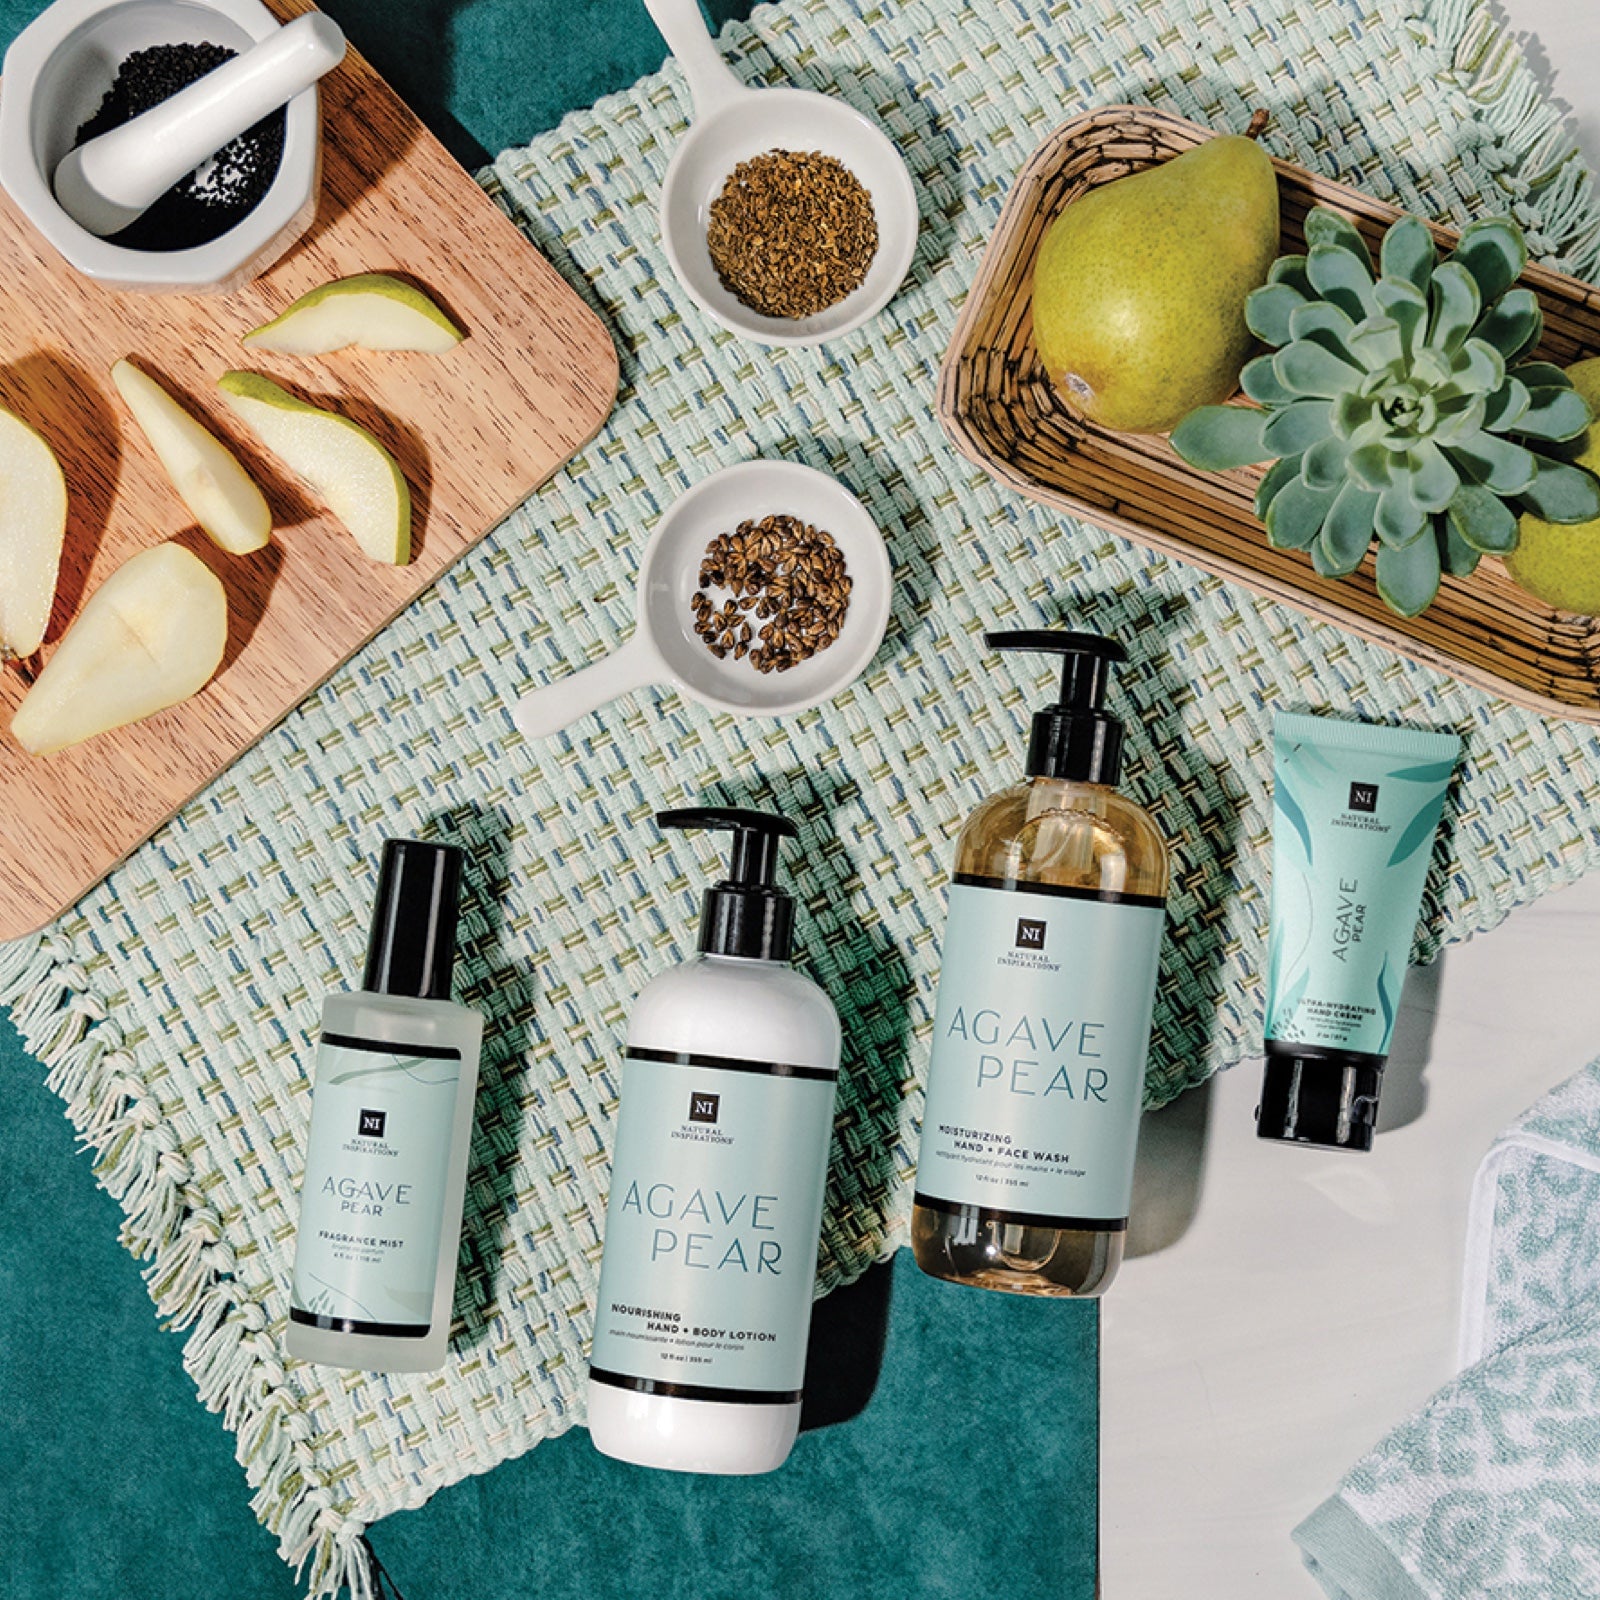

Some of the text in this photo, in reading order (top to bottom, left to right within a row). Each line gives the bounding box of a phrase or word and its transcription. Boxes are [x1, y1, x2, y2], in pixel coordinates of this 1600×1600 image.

[1355, 790, 1373, 805] NI
[1341, 813, 1380, 825] NATURAL
[1332, 878, 1358, 963] AGAVE
[1352, 904, 1367, 943] PEAR
[1022, 926, 1041, 942] NI
[1008, 951, 1049, 962] NATURAL
[1307, 1008, 1332, 1017] HAND
[947, 1006, 1105, 1058] AGAVE
[976, 1055, 1109, 1103] PEAR
[695, 1100, 714, 1115] NI
[363, 1116, 381, 1130] NI
[682, 1125, 722, 1136] NATURAL
[938, 1124, 1012, 1145] MOISTURIZING
[351, 1139, 389, 1150] NATURAL
[954, 1141, 983, 1153] HAND
[997, 1148, 1029, 1160] FACE
[1033, 1151, 1070, 1163] WASH
[321, 1176, 412, 1205] AGAVE
[341, 1201, 383, 1217] PEAR
[622, 1179, 779, 1230] AGAVE
[319, 1230, 404, 1248] FRAGRANCE MIST
[651, 1228, 782, 1275] PEAR
[611, 1303, 682, 1322] NOURISHING
[647, 1321, 679, 1334] HAND
[693, 1327, 726, 1338] BODY
[729, 1331, 776, 1342] LOTION
